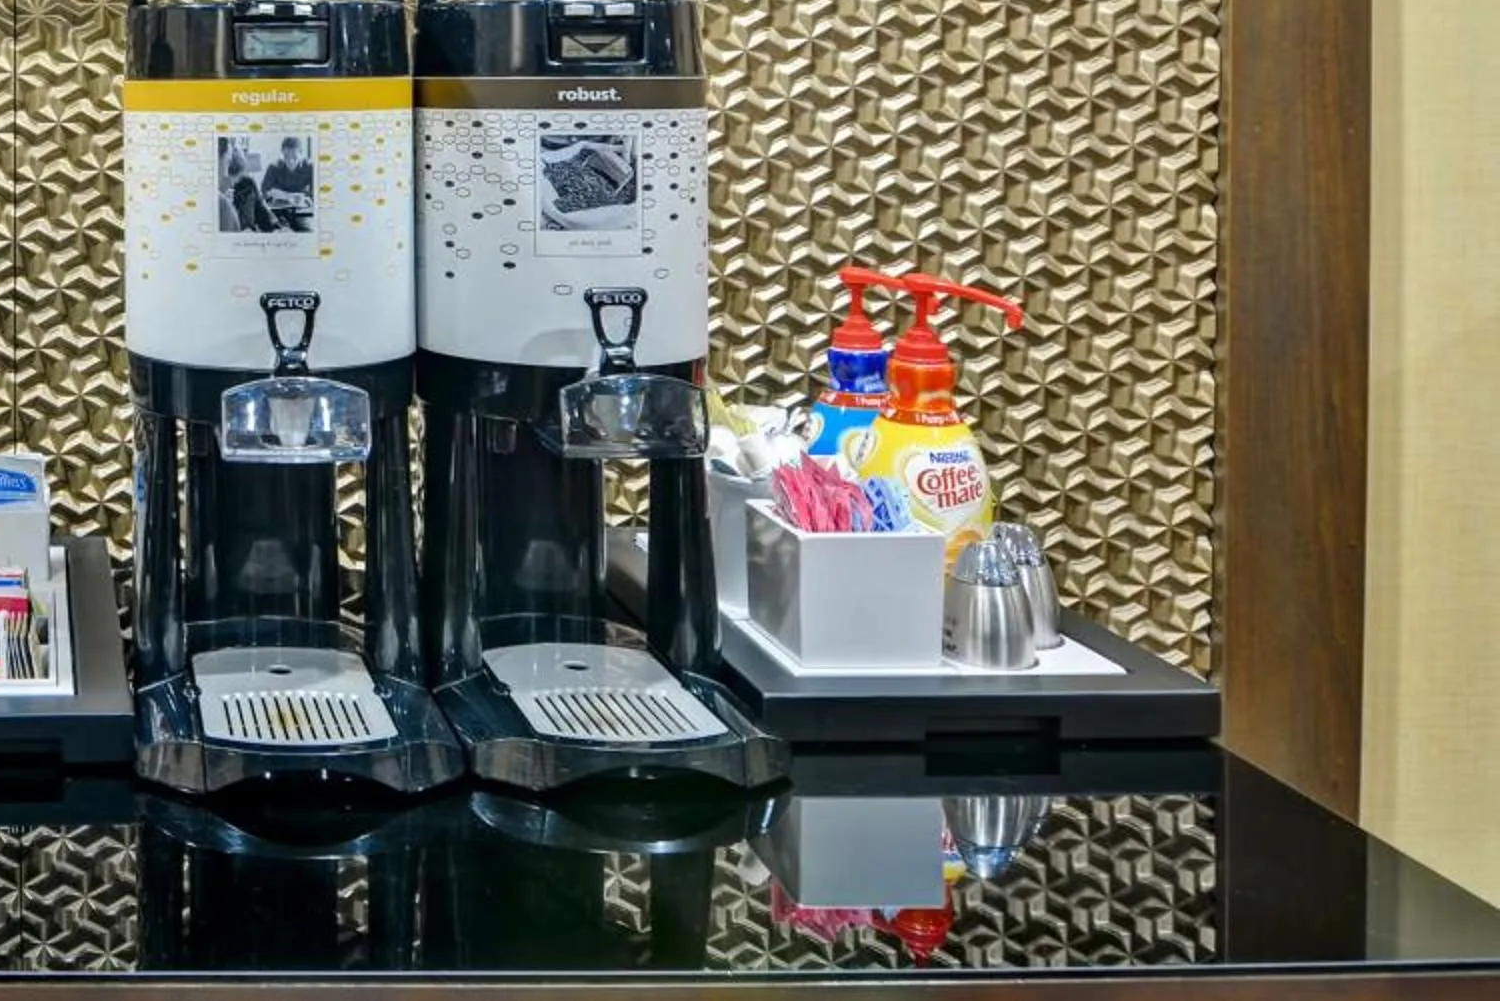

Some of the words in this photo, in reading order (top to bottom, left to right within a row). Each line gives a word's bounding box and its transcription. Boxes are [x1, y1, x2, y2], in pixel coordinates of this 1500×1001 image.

[231, 89, 300, 106] regular.
[557, 86, 622, 102] robust.
[937, 480, 983, 509] mate
